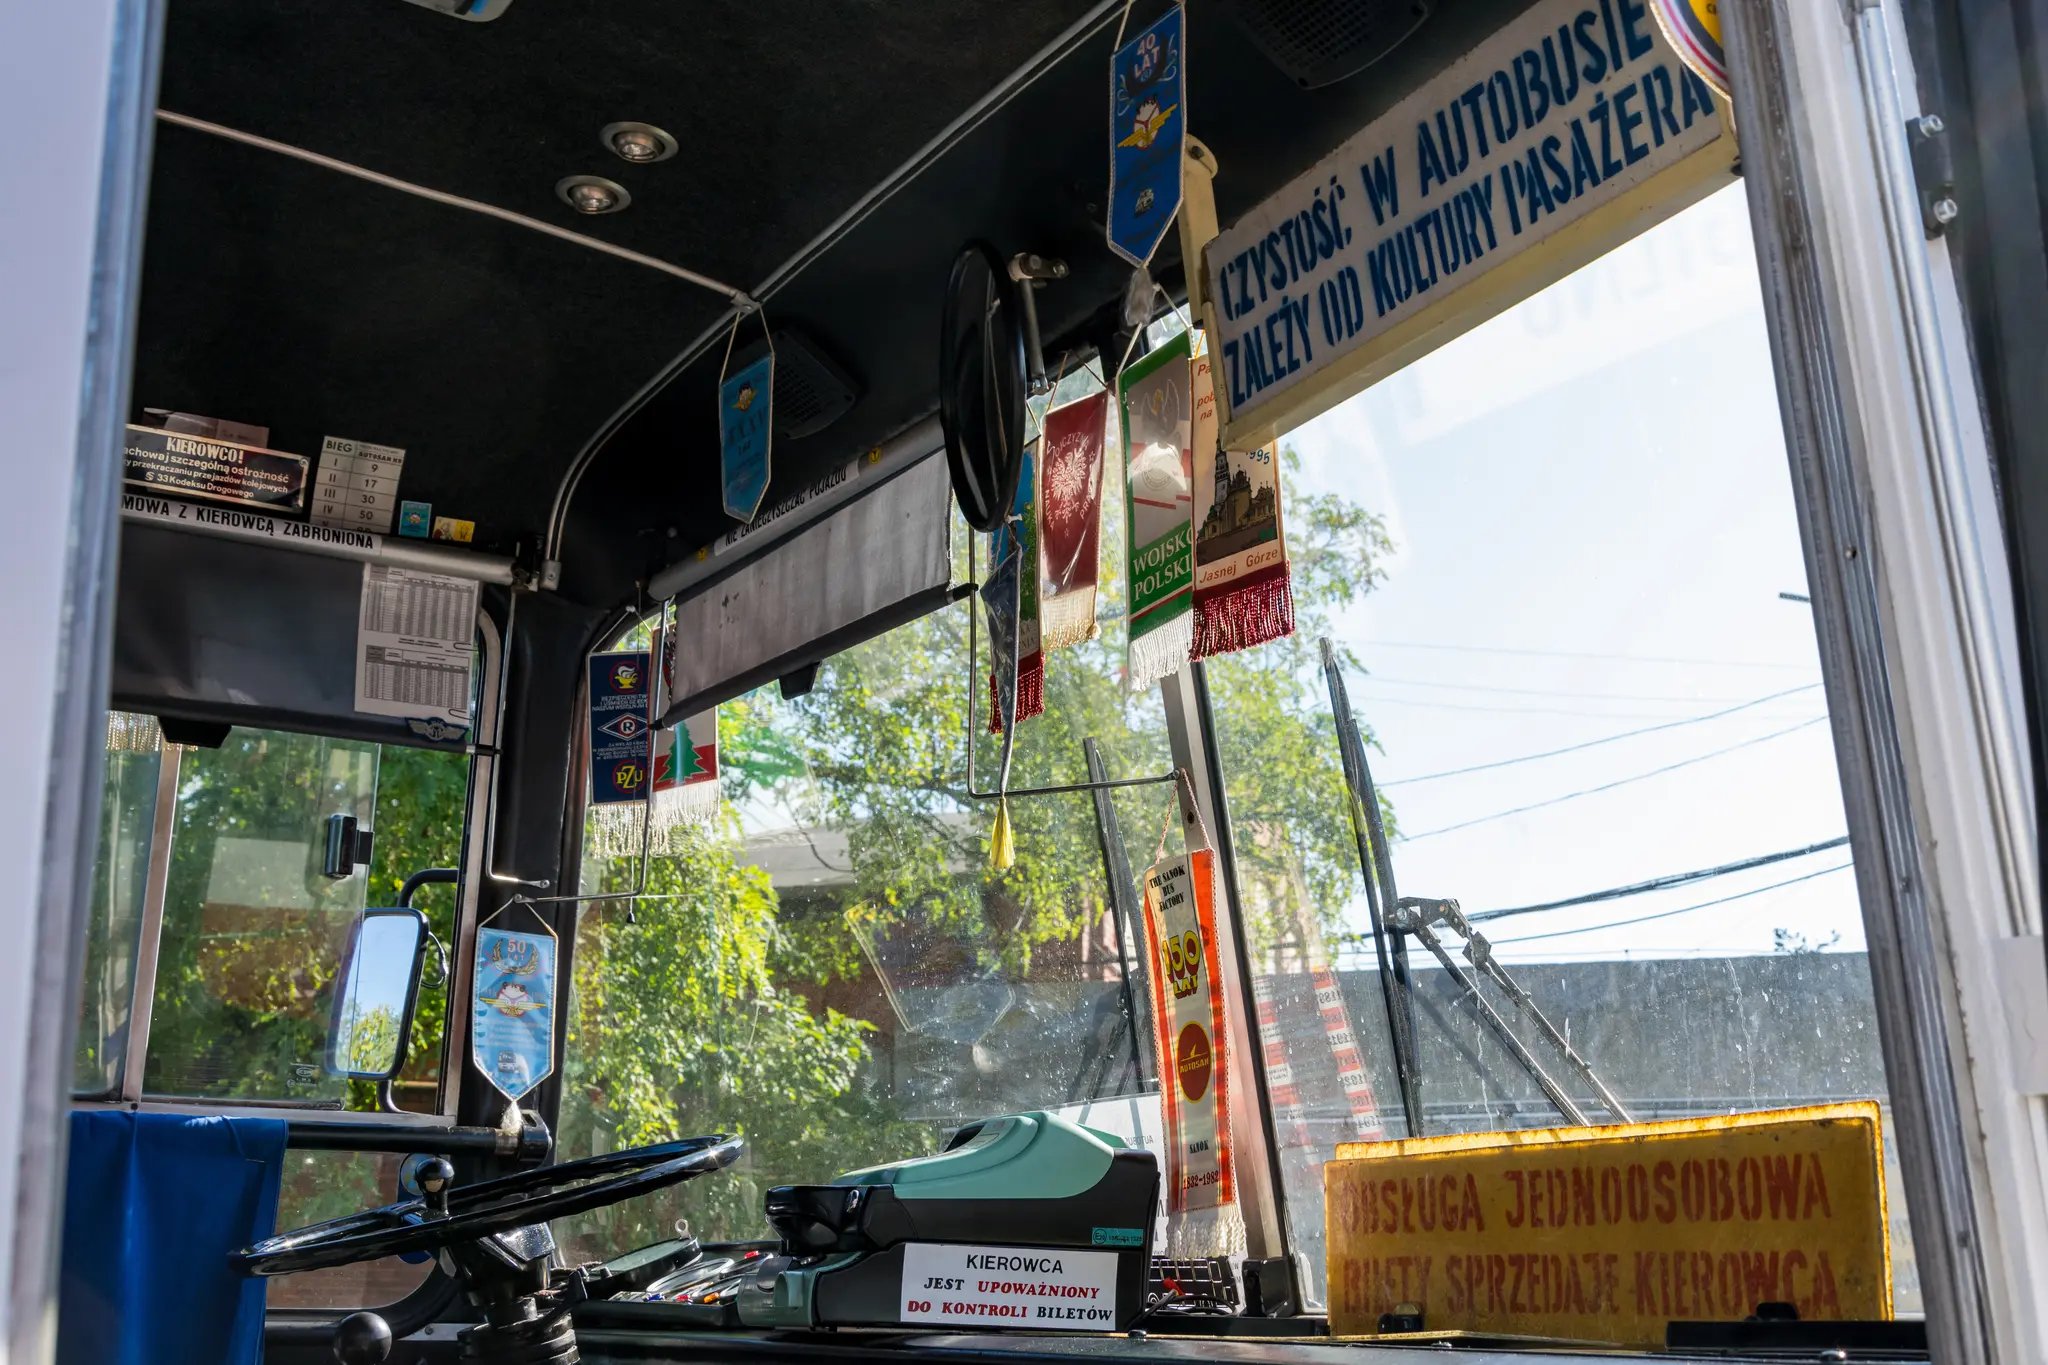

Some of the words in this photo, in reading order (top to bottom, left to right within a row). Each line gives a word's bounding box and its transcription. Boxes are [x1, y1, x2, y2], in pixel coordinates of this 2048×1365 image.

[1136, 33, 1156, 56] 40
[1134, 46, 1160, 79] LAT
[1220, 175, 1352, 321] CZYSTOŚĆ
[1360, 146, 1399, 226] W
[1415, 0, 1654, 197] AUTOBUSIE
[1223, 292, 1313, 408] ZALEŻY
[1321, 267, 1364, 347] OD
[1368, 174, 1499, 317] KULTURY
[1501, 63, 1716, 236] PASAŻERA
[1197, 364, 1211, 376] Pa
[1196, 392, 1215, 410] pob
[1200, 410, 1212, 421] na
[166, 437, 244, 464] KIEROWCO!
[326, 440, 352, 452] BIEG
[1246, 449, 1270, 465] 995
[124, 447, 169, 463] achowaj
[171, 455, 229, 474] szczególną
[231, 466, 289, 483] ostrożność
[372, 464, 378, 472] 9
[132, 460, 192, 476] przekraczaniu
[193, 471, 242, 485] przejazdów
[242, 478, 288, 493] kolejowych
[157, 473, 168, 482] 33
[169, 475, 206, 490] Kodeksu
[206, 483, 254, 498] Drogowego
[329, 473, 336, 482] II
[365, 479, 377, 488] 17
[809, 466, 848, 499] POJAZDU
[324, 488, 336, 498] III
[361, 494, 375, 504] 30
[122, 495, 170, 516] MOWA
[179, 504, 187, 519] Z
[196, 506, 275, 536] KIEROWCĄ
[284, 522, 374, 550] ZABRONIONA
[323, 504, 333, 514] IV
[359, 510, 373, 520] 50
[1134, 553, 1192, 601] POLSKI
[1200, 562, 1236, 583] Jasnej
[1246, 549, 1278, 568] Górze
[623, 721, 633, 732] R
[616, 765, 643, 789] PZU
[1149, 875, 1162, 888] THE
[1162, 865, 1185, 881] SANOK
[1162, 883, 1175, 897] BUS
[1159, 892, 1185, 912] FACTORY
[508, 937, 526, 953] 50
[1162, 930, 1200, 982] 150
[1173, 974, 1199, 998] LAT
[1180, 1058, 1209, 1073] AUTOSAN
[1189, 1140, 1209, 1154] SANOK
[1183, 1170, 1219, 1190] 1832-1982
[1339, 1172, 1486, 1236] OBSŁUGA
[1503, 1151, 1833, 1228] JEDNOOSOBOWA
[966, 1254, 1063, 1274] KIEROWCA
[924, 1277, 965, 1290] JEST
[978, 1281, 1100, 1299] UPOWAŻNIONY
[1446, 1250, 1620, 1316] SPRZEDAJE
[1635, 1249, 1844, 1320] KIEROWCA
[908, 1300, 931, 1312] DO
[941, 1302, 1028, 1317] KONTROLI
[1036, 1304, 1113, 1321] BILETÓW
